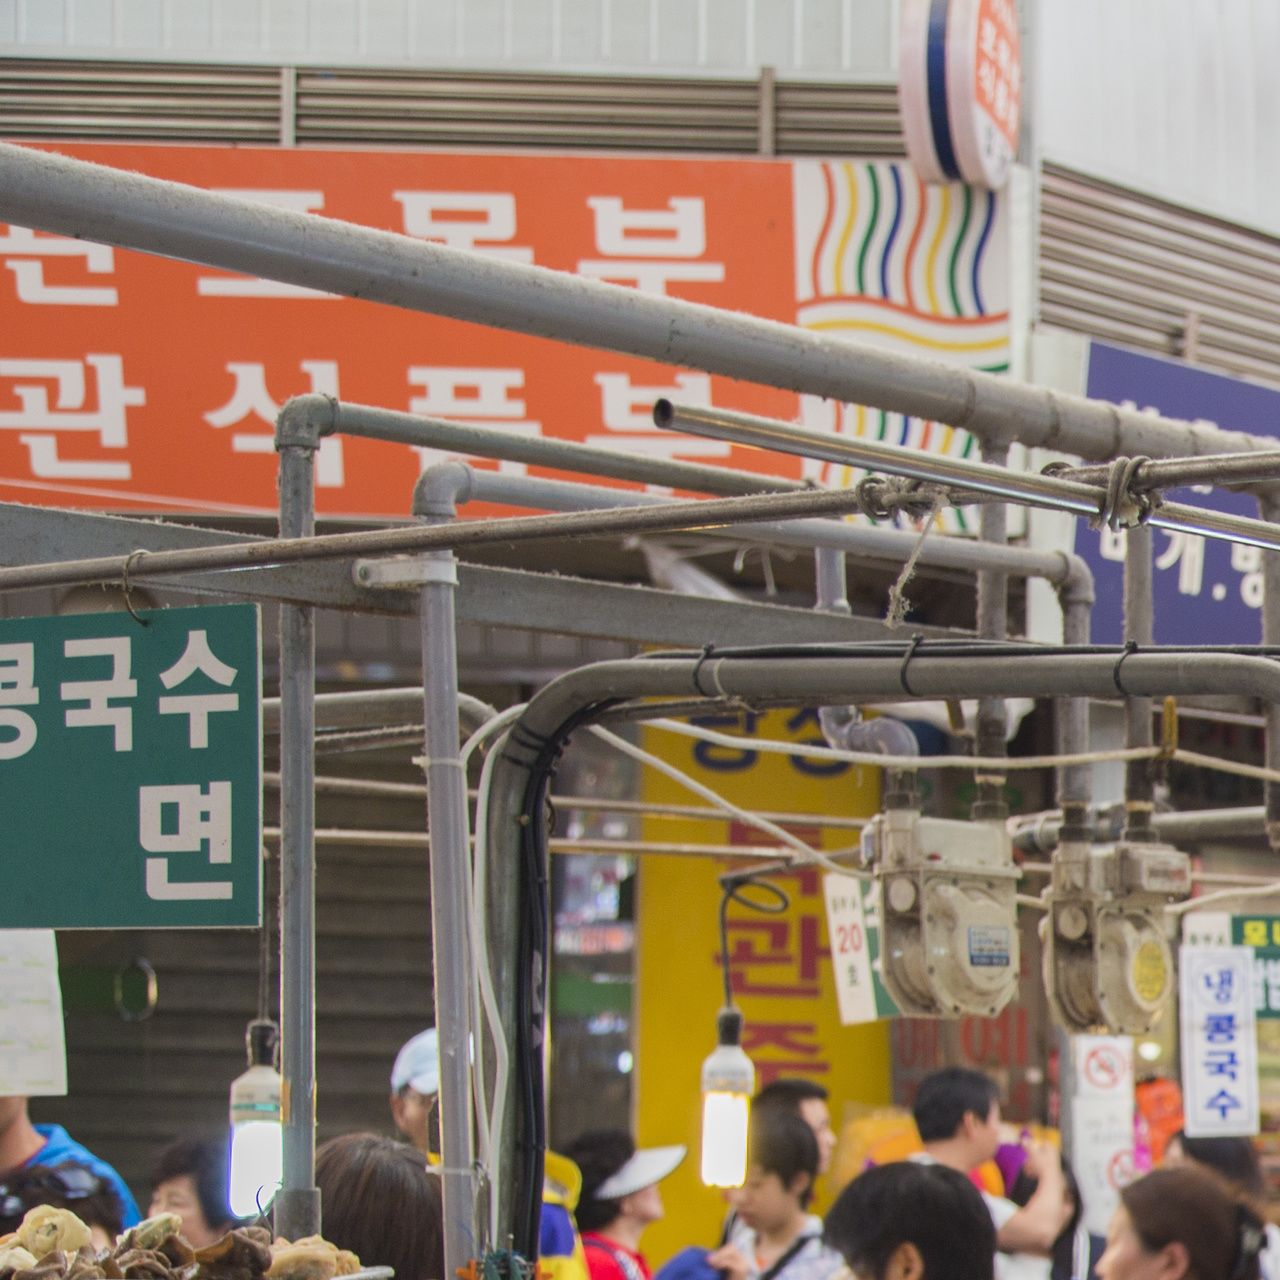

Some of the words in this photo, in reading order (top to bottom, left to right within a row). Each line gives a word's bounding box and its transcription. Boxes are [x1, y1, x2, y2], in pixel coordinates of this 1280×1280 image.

[139, 781, 233, 900] 면
[836, 923, 863, 954] 20
[1204, 969, 1242, 1120] 냉콩국수
